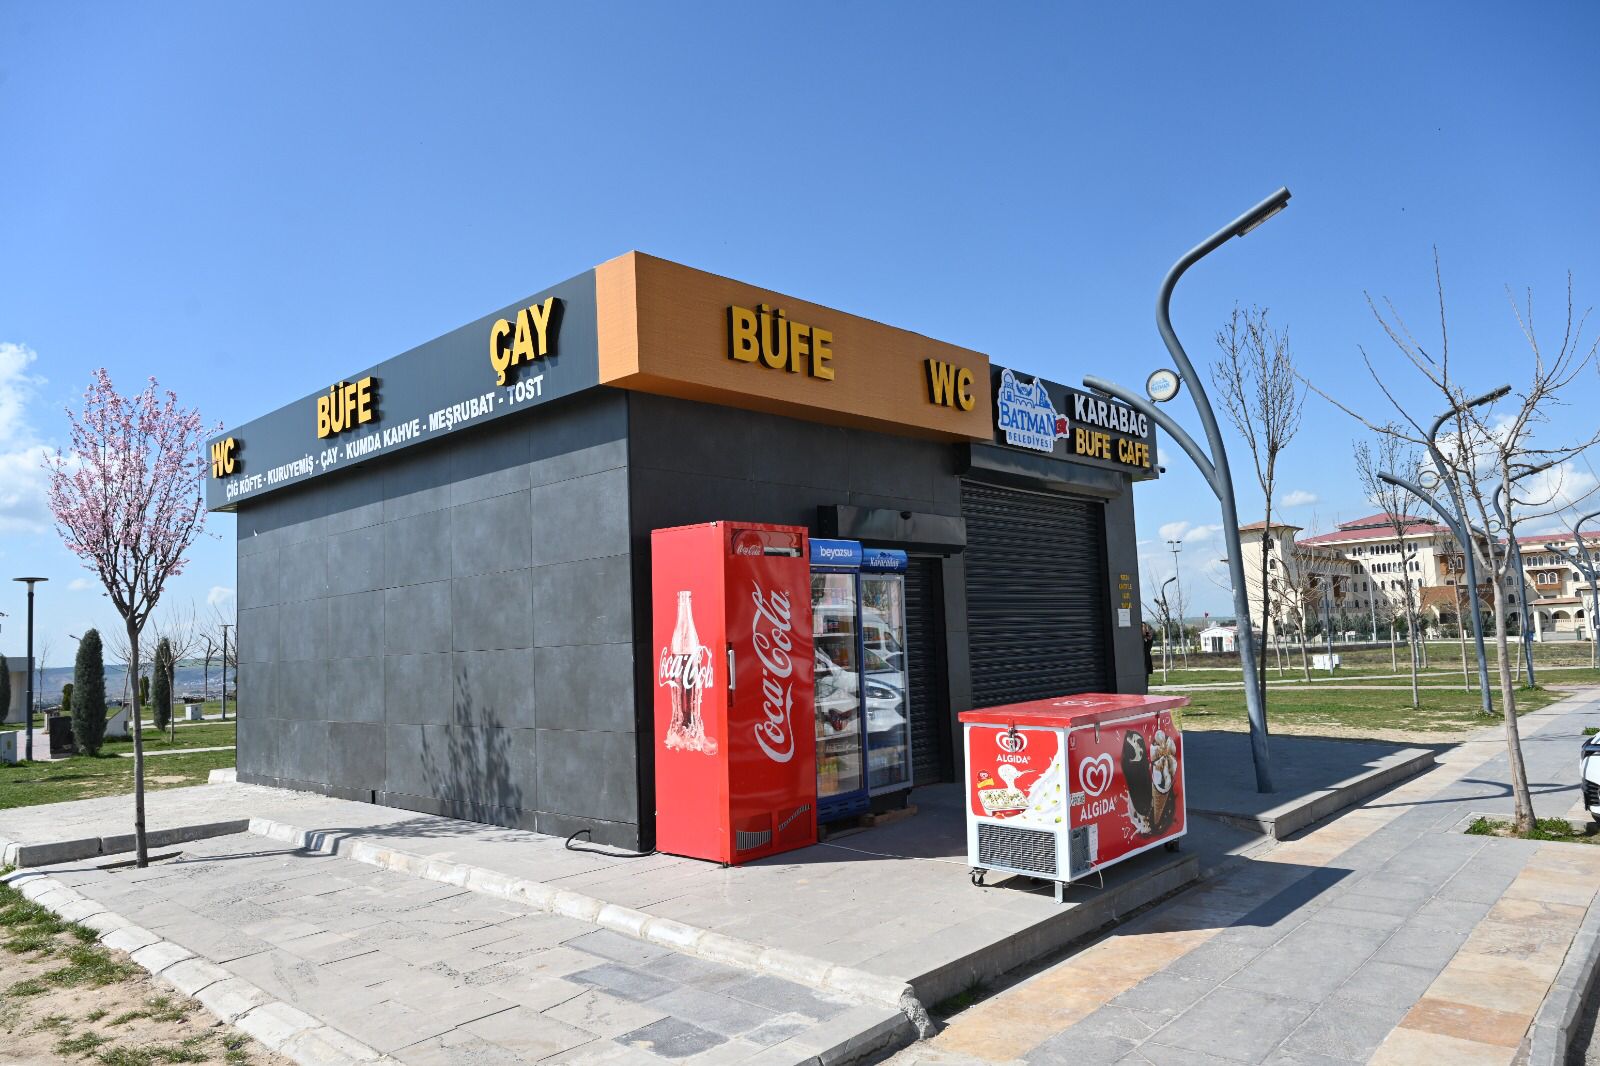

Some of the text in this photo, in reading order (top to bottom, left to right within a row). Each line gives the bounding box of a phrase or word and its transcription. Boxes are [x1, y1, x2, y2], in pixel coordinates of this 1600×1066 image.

[490, 297, 554, 386] ÇAY
[728, 303, 835, 381] BÜFE
[317, 376, 372, 438] BÜFE
[926, 358, 976, 412] WC
[239, 473, 263, 495] KÖFTE
[267, 453, 314, 486] KURUYEMİŞ
[320, 446, 339, 471] ÇAY
[345, 433, 382, 460] KUMDA
[383, 418, 421, 448] KAHVE
[429, 391, 496, 431] MEŞRUBAT
[507, 374, 544, 406] TOST
[1000, 401, 1057, 438] BATMAN
[1073, 393, 1149, 438] KARABAG
[211, 436, 235, 479] WC
[1008, 431, 1052, 449] BELEDİYESİ
[1075, 427, 1151, 468] BUFE CAFE
[820, 545, 853, 560] beyazsu
[658, 645, 714, 690] Coca-Cola
[752, 579, 795, 764] Coca-Cola
